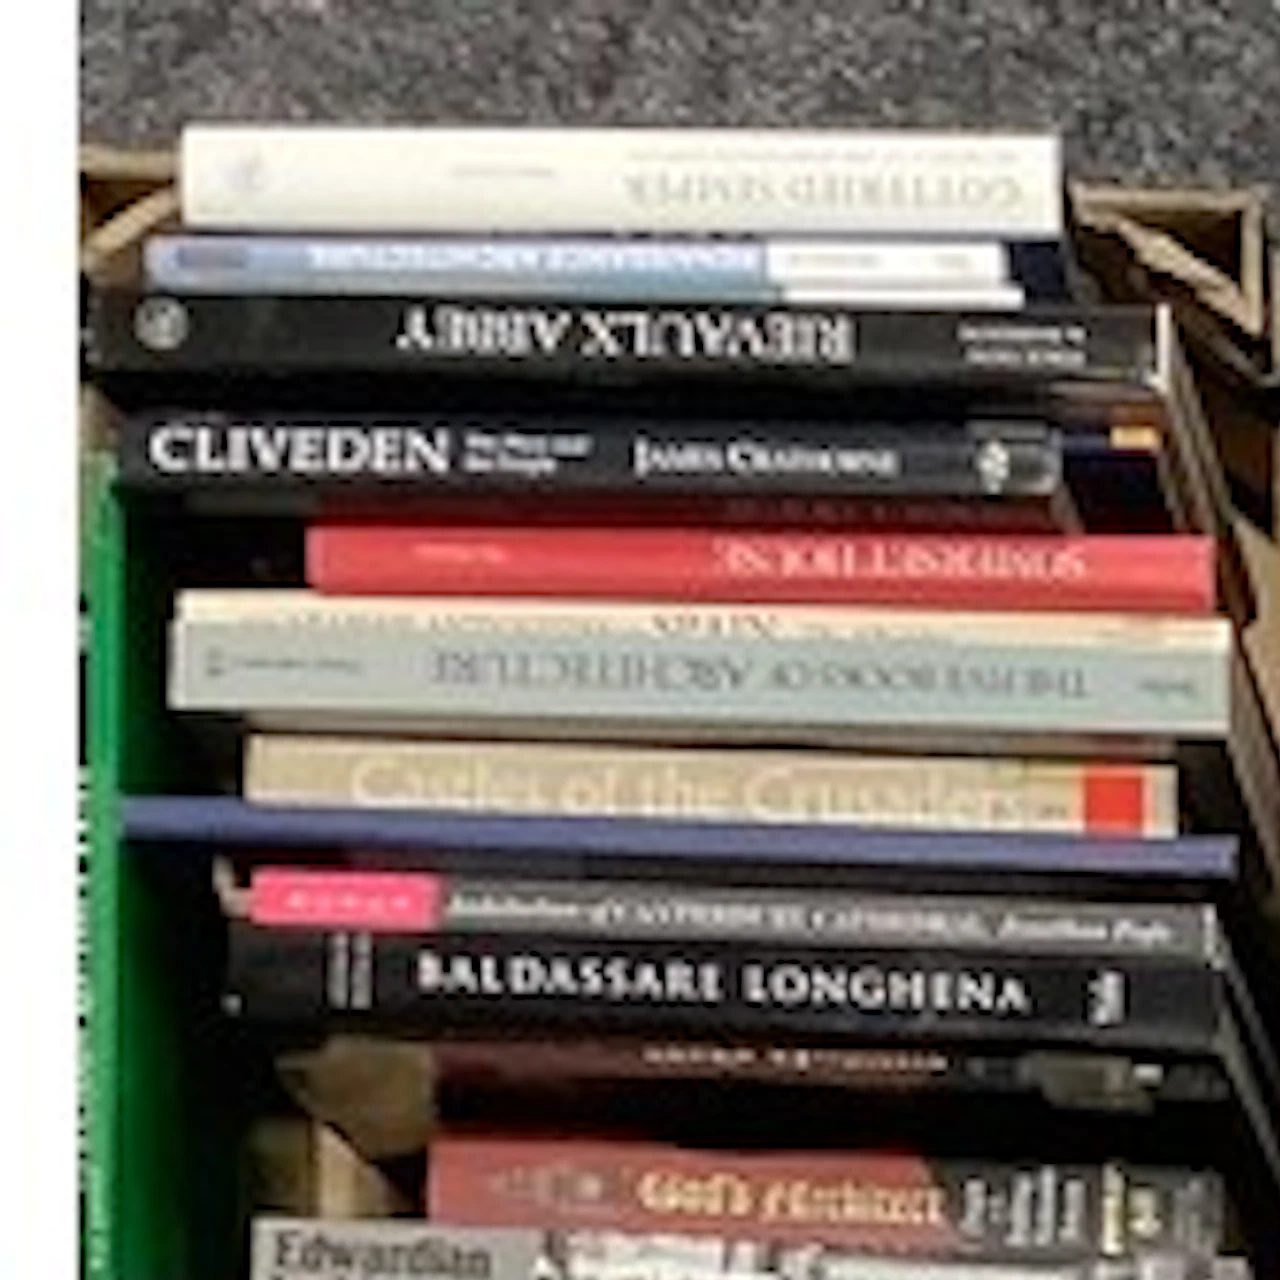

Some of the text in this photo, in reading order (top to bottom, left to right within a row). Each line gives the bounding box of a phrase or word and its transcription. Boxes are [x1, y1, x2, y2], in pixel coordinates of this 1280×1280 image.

[398, 309, 569, 356] ABBEY
[580, 314, 856, 362] RIEVAULX
[148, 424, 452, 476] CLIVEDEN
[431, 652, 755, 692] ARCHITECTURE
[417, 953, 1030, 1016] BALDASSARE LONGHENA
